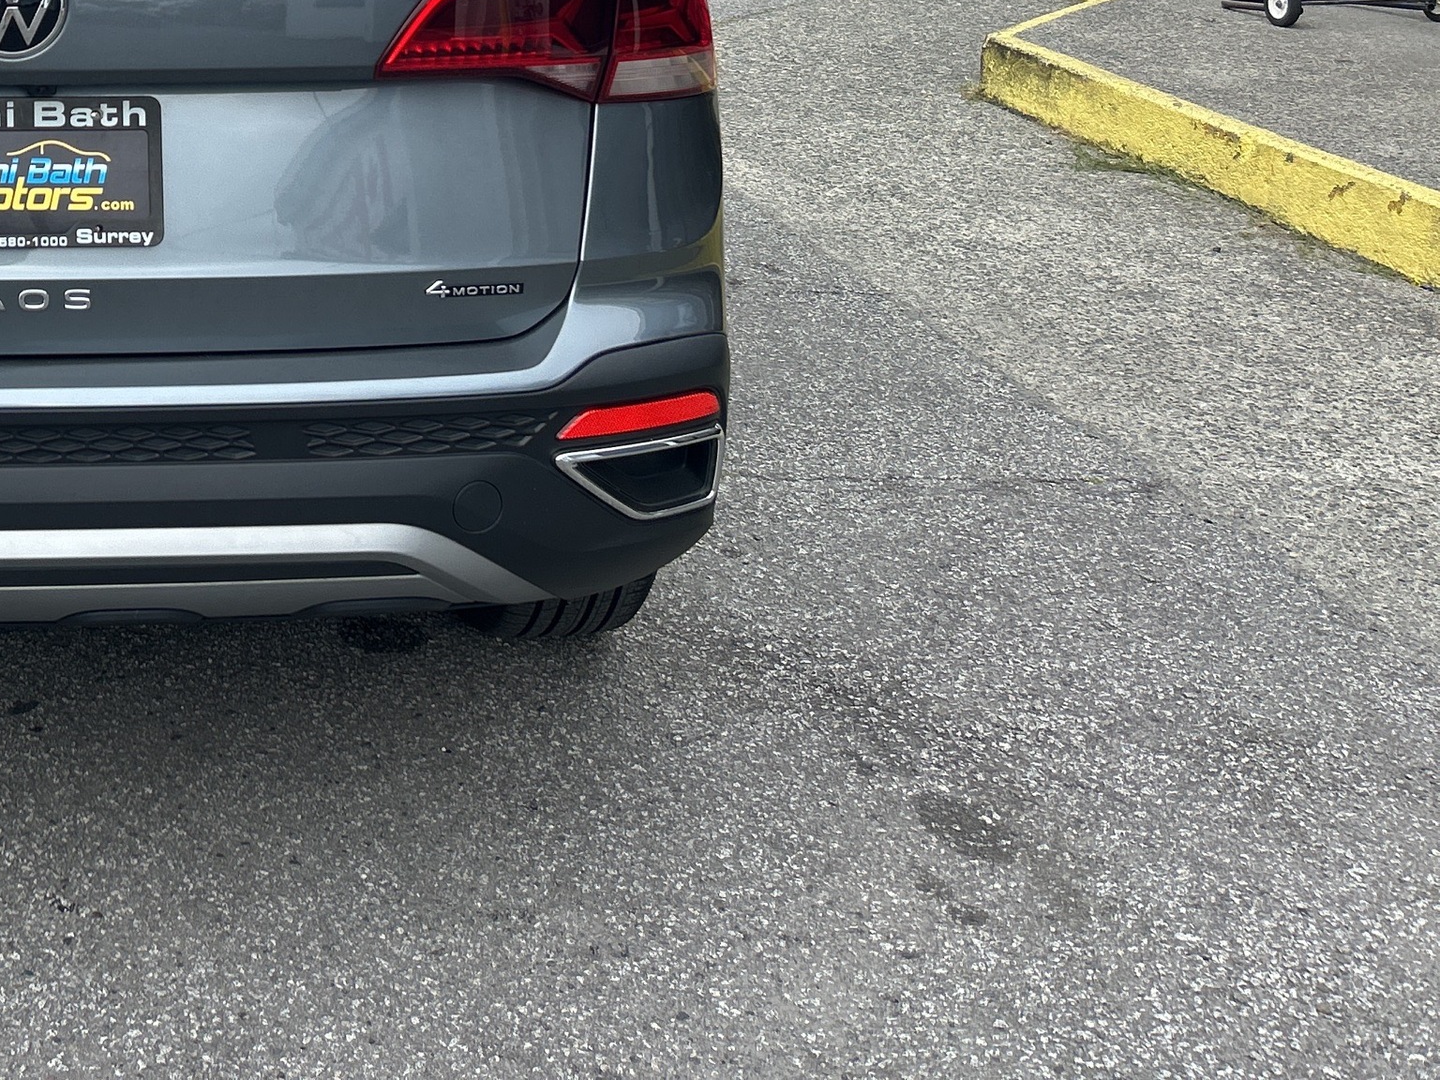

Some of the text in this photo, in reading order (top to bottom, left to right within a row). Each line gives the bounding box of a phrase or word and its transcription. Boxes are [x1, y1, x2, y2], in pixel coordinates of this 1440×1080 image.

[33, 100, 146, 128] Bath
[26, 158, 108, 184] Bath
[76, 228, 154, 246] Surrey
